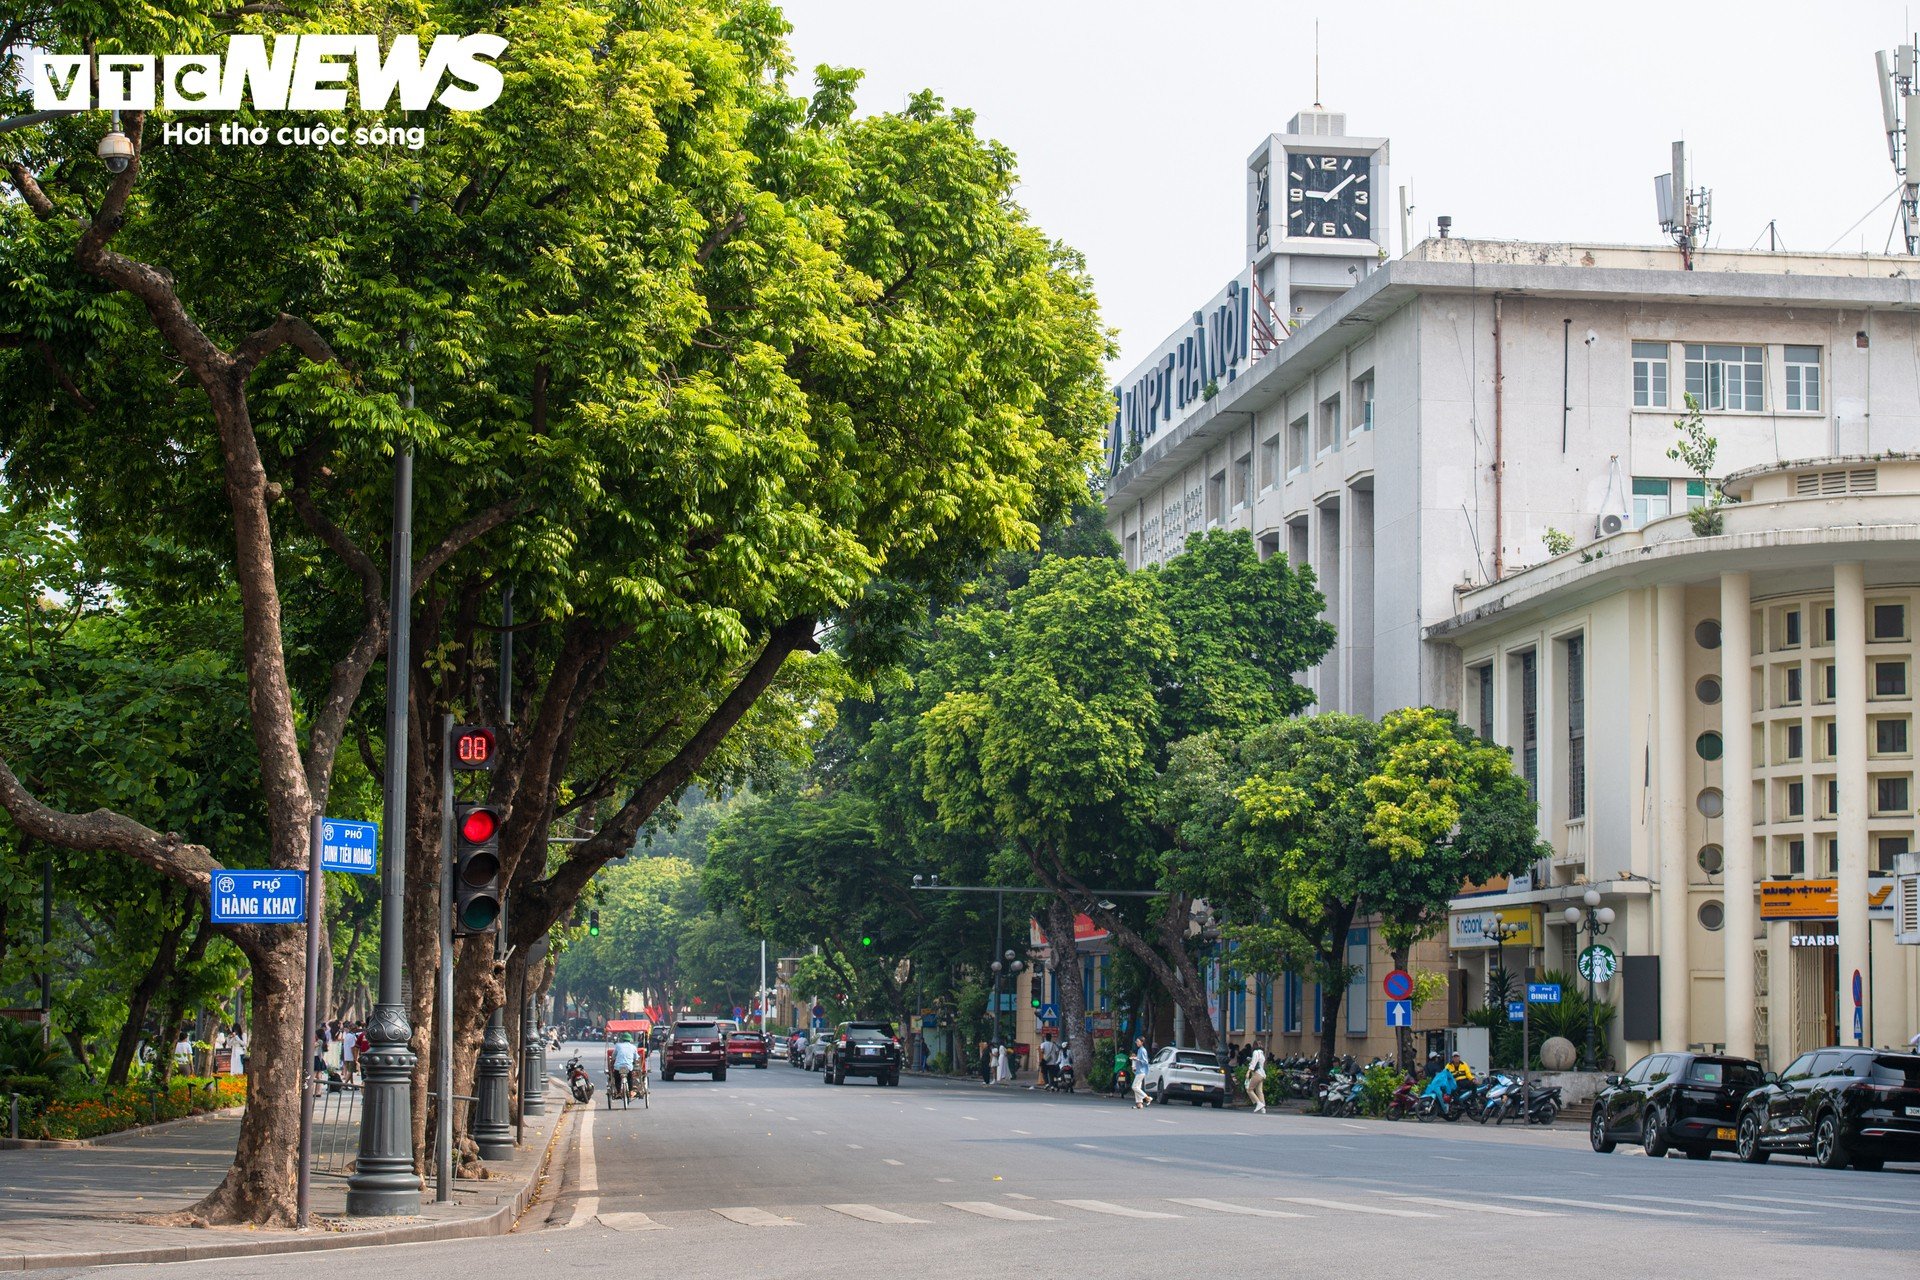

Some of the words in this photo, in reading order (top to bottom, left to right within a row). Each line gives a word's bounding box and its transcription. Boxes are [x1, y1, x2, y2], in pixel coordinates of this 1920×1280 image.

[1321, 157, 1337, 170] 12
[1290, 188, 1303, 202] 9
[1355, 191, 1368, 205] 3
[1322, 222, 1336, 236] 6
[1123, 353, 1175, 446] VNPT
[1175, 311, 1208, 410] HÀ
[1208, 280, 1249, 386] NỘI
[460, 736, 486, 760] 08
[344, 827, 363, 839] PHỐ
[221, 893, 258, 915] HÀNG
[263, 897, 296, 915] KHAY
